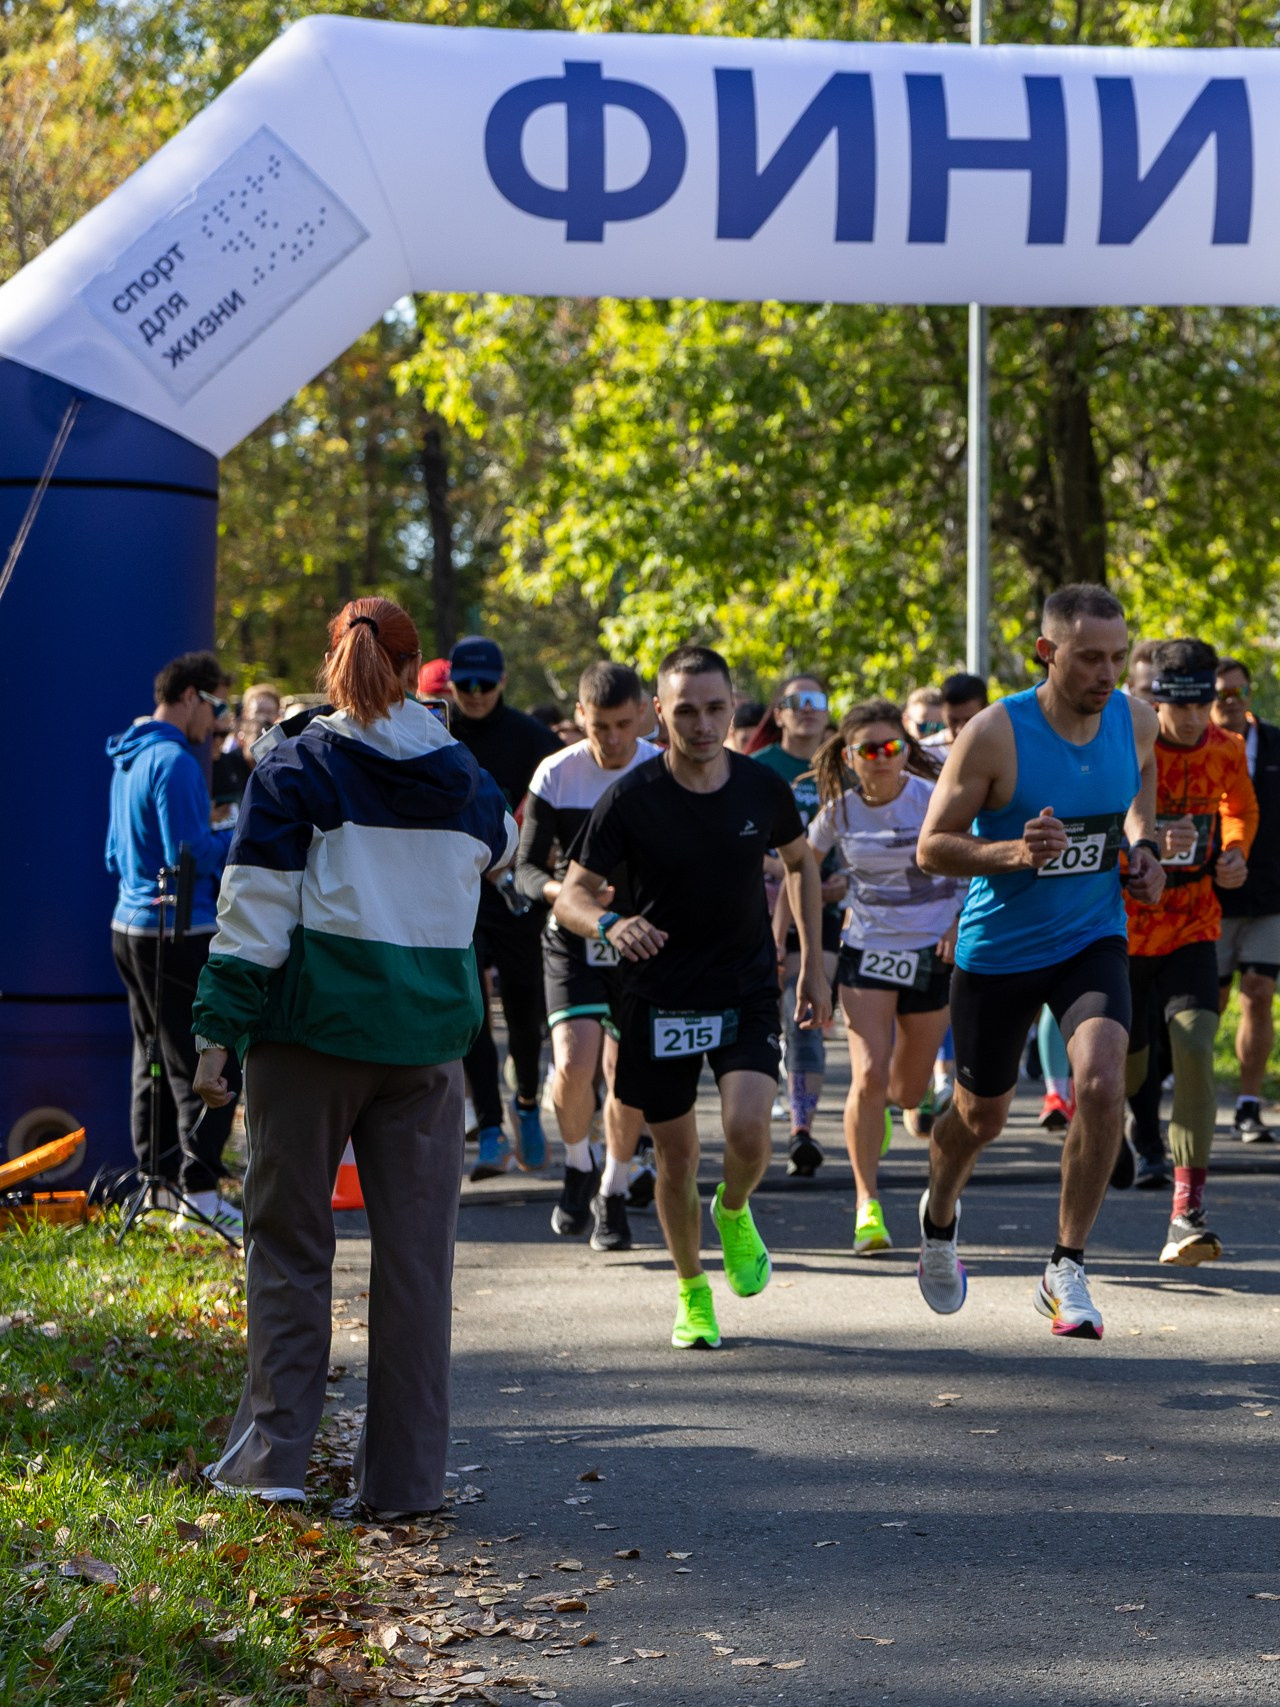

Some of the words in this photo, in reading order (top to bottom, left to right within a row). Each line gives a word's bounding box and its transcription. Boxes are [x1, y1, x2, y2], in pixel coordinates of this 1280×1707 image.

[112, 241, 185, 313] спорт
[138, 291, 189, 346] для
[162, 288, 246, 369] жизни
[593, 942, 622, 961] 21
[865, 953, 912, 979] 220
[663, 1026, 713, 1052] 215
